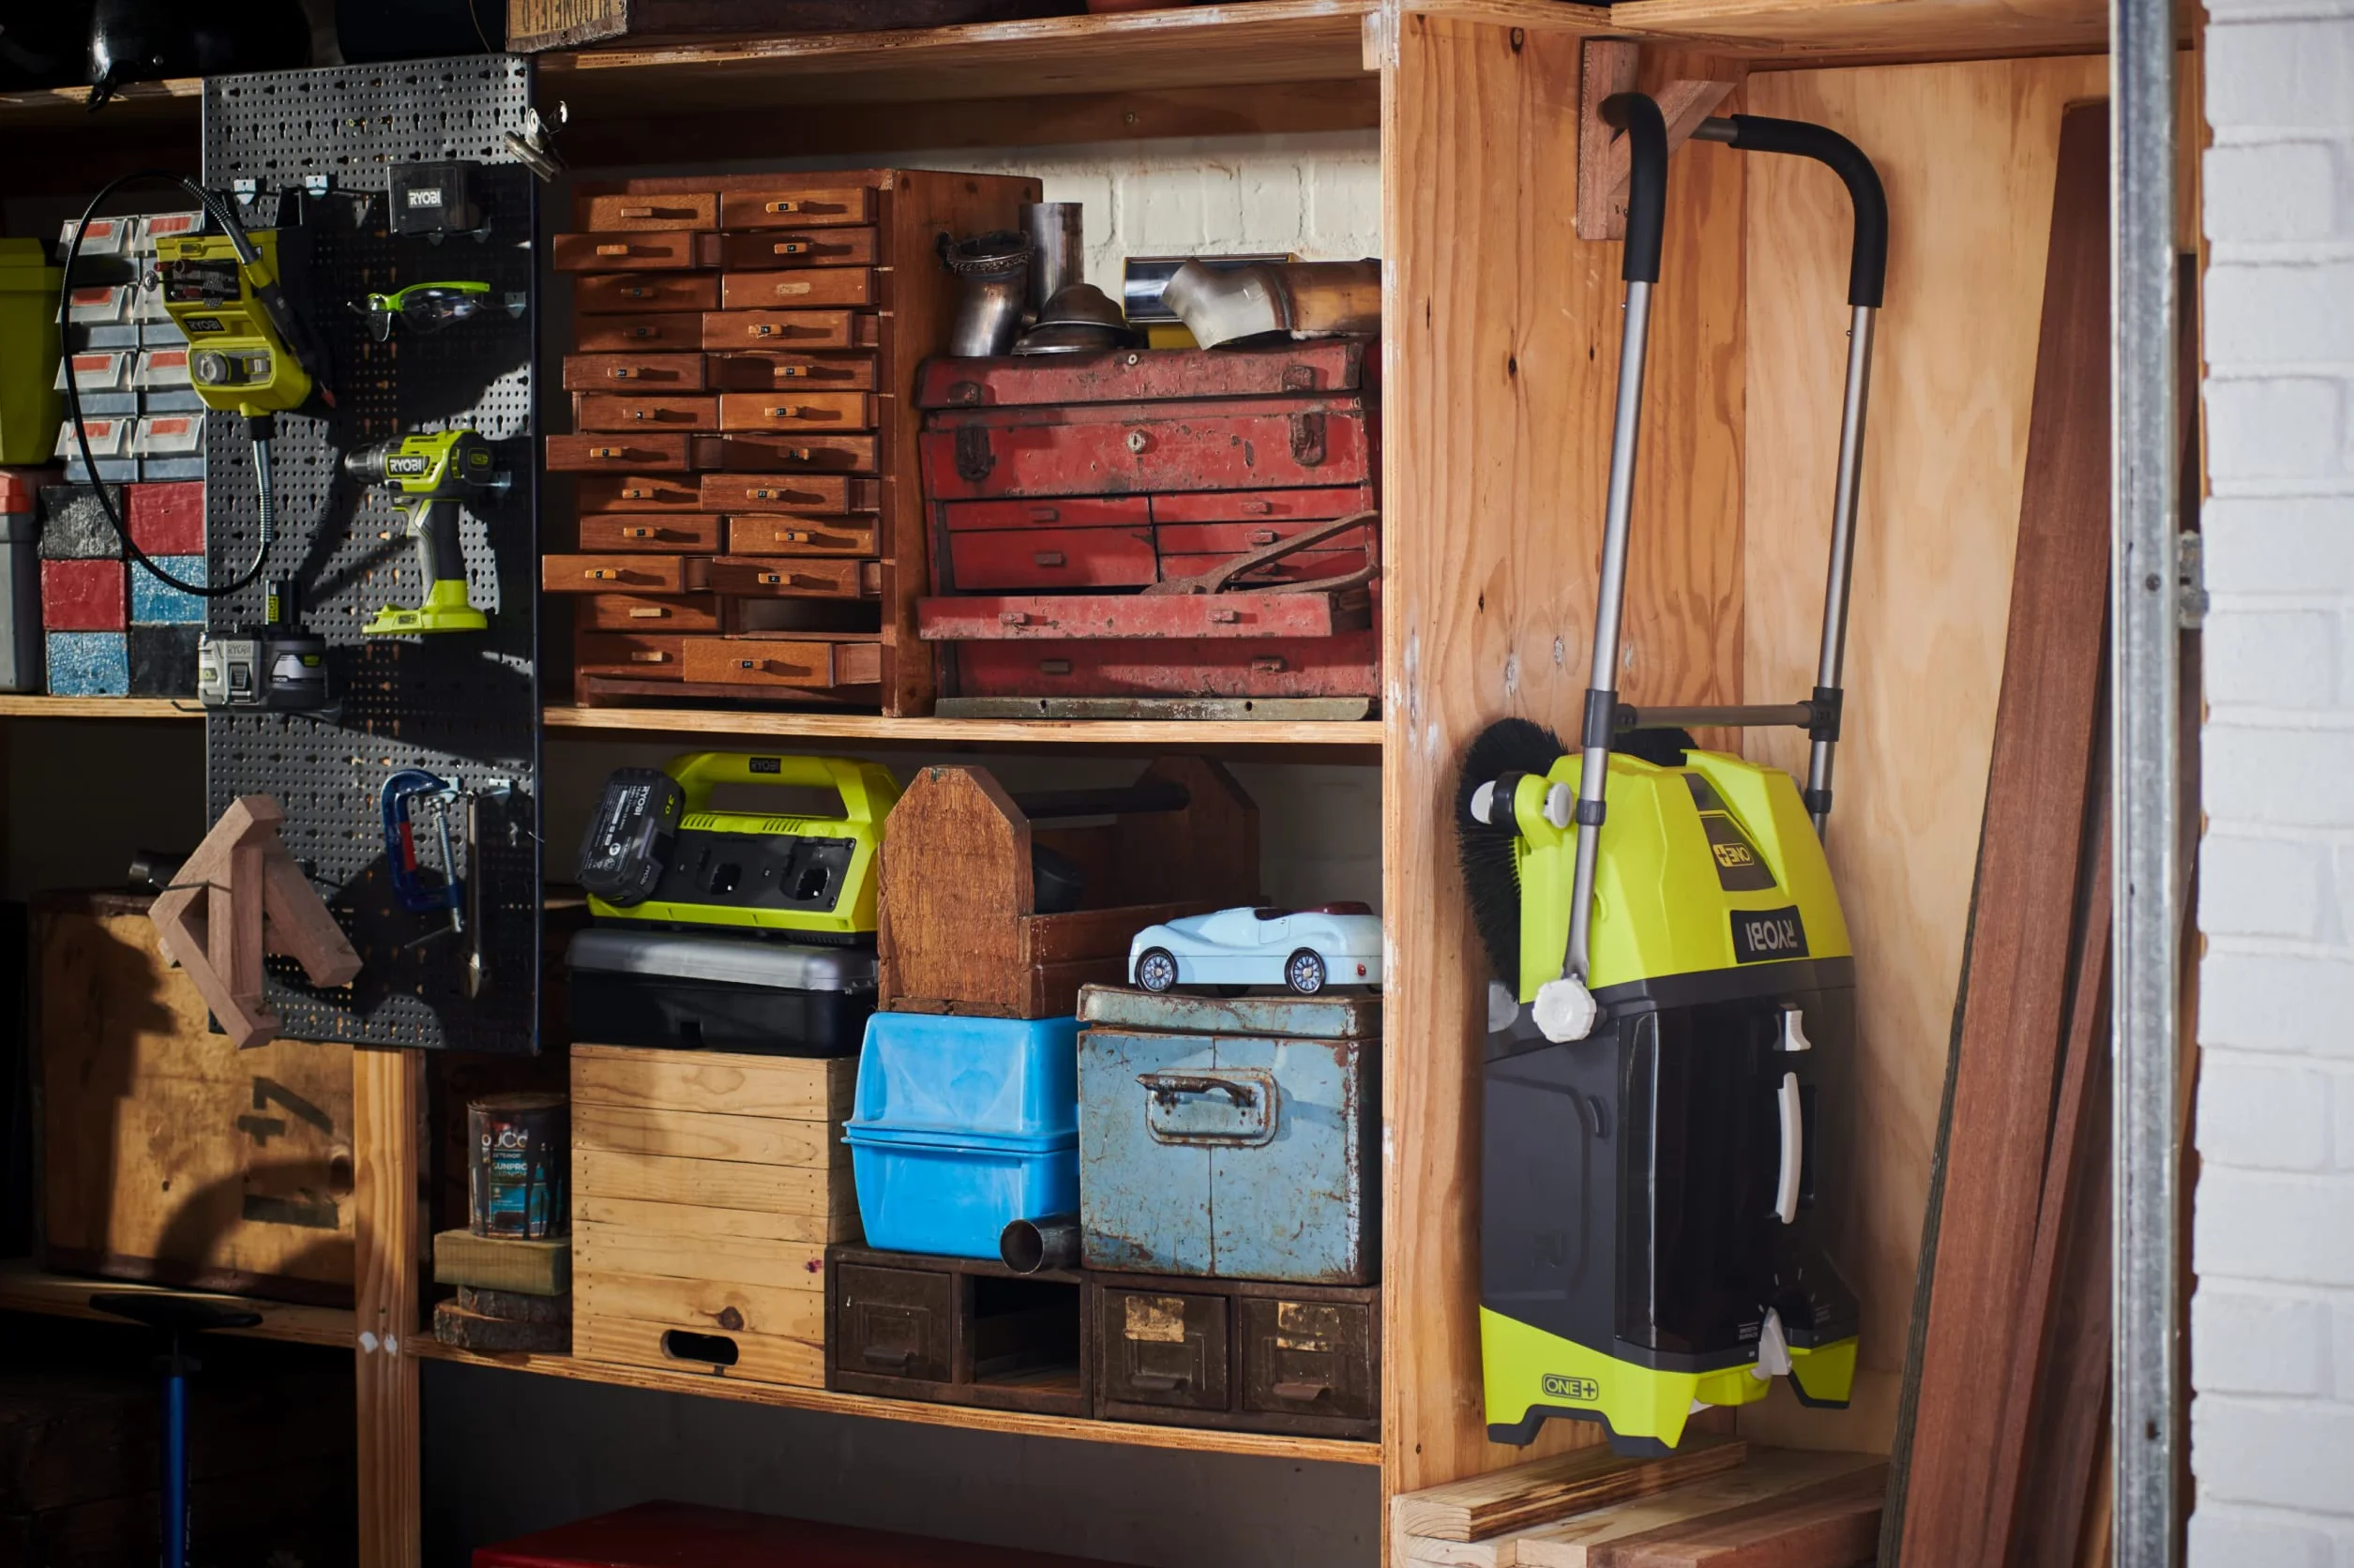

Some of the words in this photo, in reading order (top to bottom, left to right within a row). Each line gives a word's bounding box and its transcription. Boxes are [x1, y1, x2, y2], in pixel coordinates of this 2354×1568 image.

[408, 190, 441, 205] RYOBI
[186, 319, 222, 330] RYOBI
[389, 459, 422, 472] RYOBI
[750, 760, 779, 772] RYOBI
[633, 785, 651, 816] RYOBI
[1714, 845, 1752, 866] ONE+
[640, 864, 652, 885] RYOBI
[1745, 919, 1799, 952] RYOBI
[1546, 1378, 1596, 1398] ONE+
